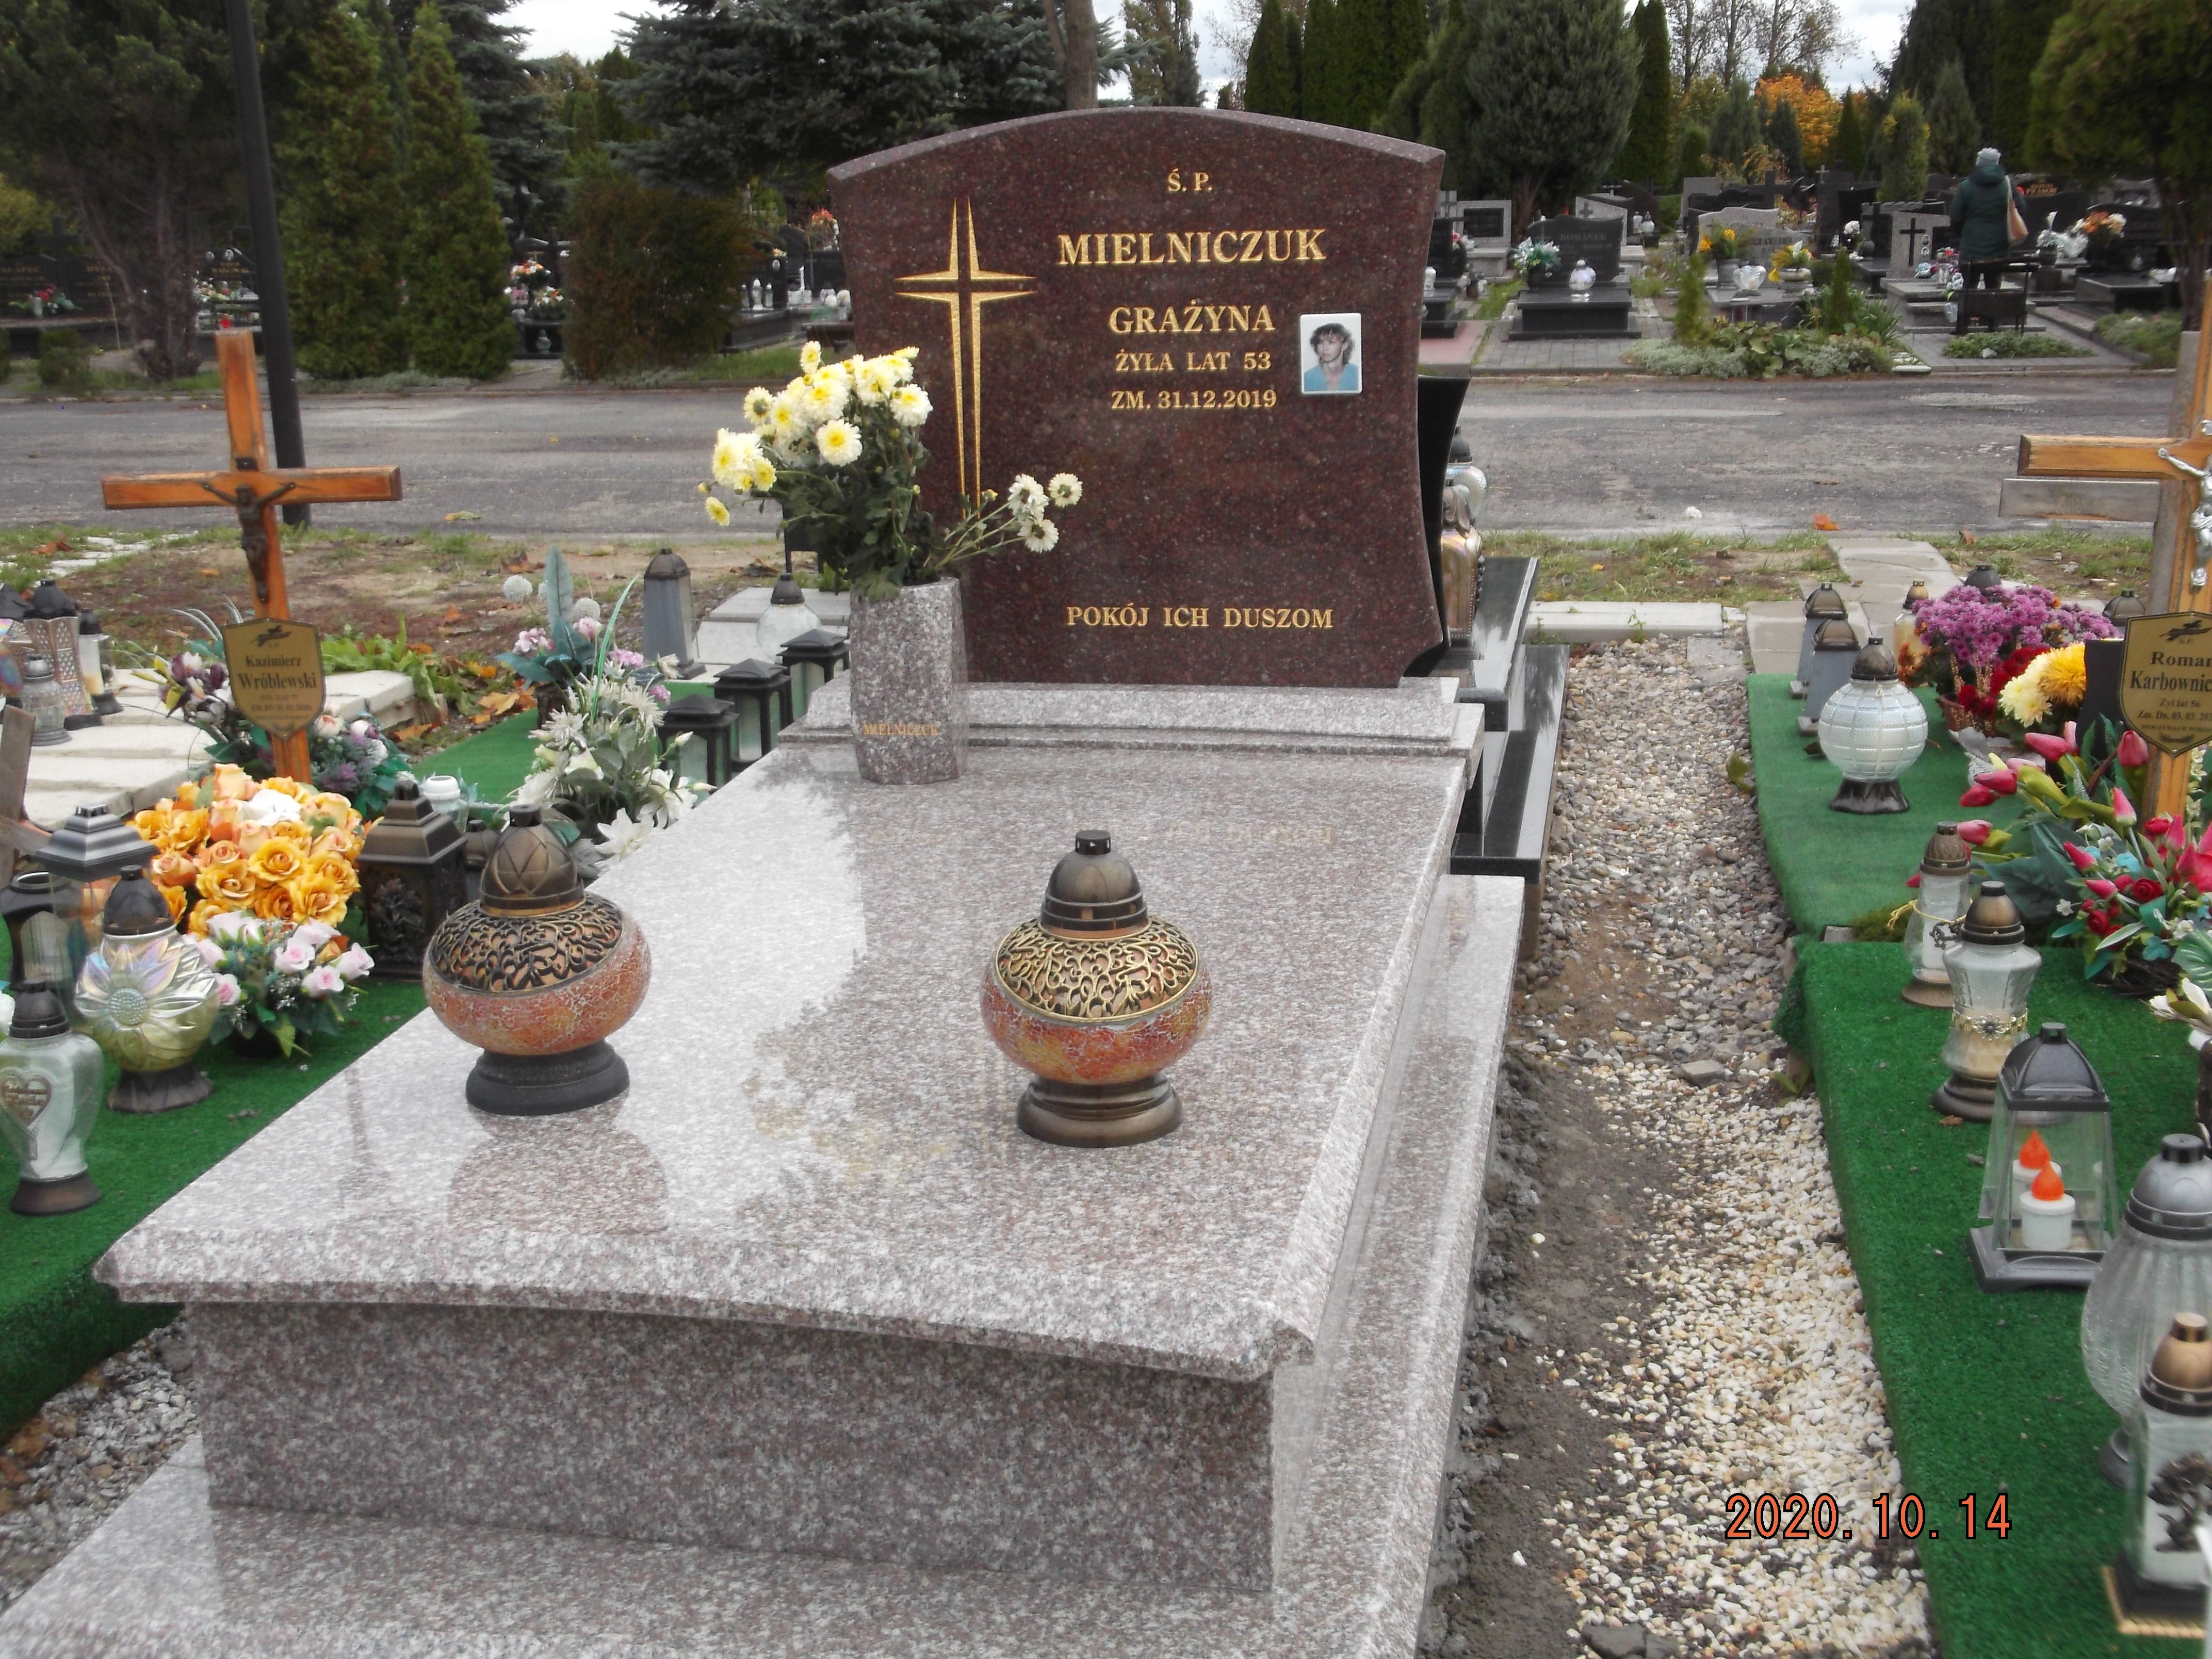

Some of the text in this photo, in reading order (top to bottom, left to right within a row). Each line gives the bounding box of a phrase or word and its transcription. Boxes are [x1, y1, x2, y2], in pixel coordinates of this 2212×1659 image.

[1057, 228, 1327, 266] MIELNICZUK
[1108, 299, 1276, 334] GRAŻYNA
[1115, 348, 1272, 371] ŻYŁA LAT 53
[1111, 388, 1277, 411] ZM. 31.12.2019
[1067, 601, 1333, 629] POKÓJ ICH DUSZOM
[246, 654, 301, 667] Kazimierz
[238, 672, 317, 689] Wróblewski
[2129, 670, 2212, 692] Karbownic
[862, 722, 939, 736] MIELNICZUK
